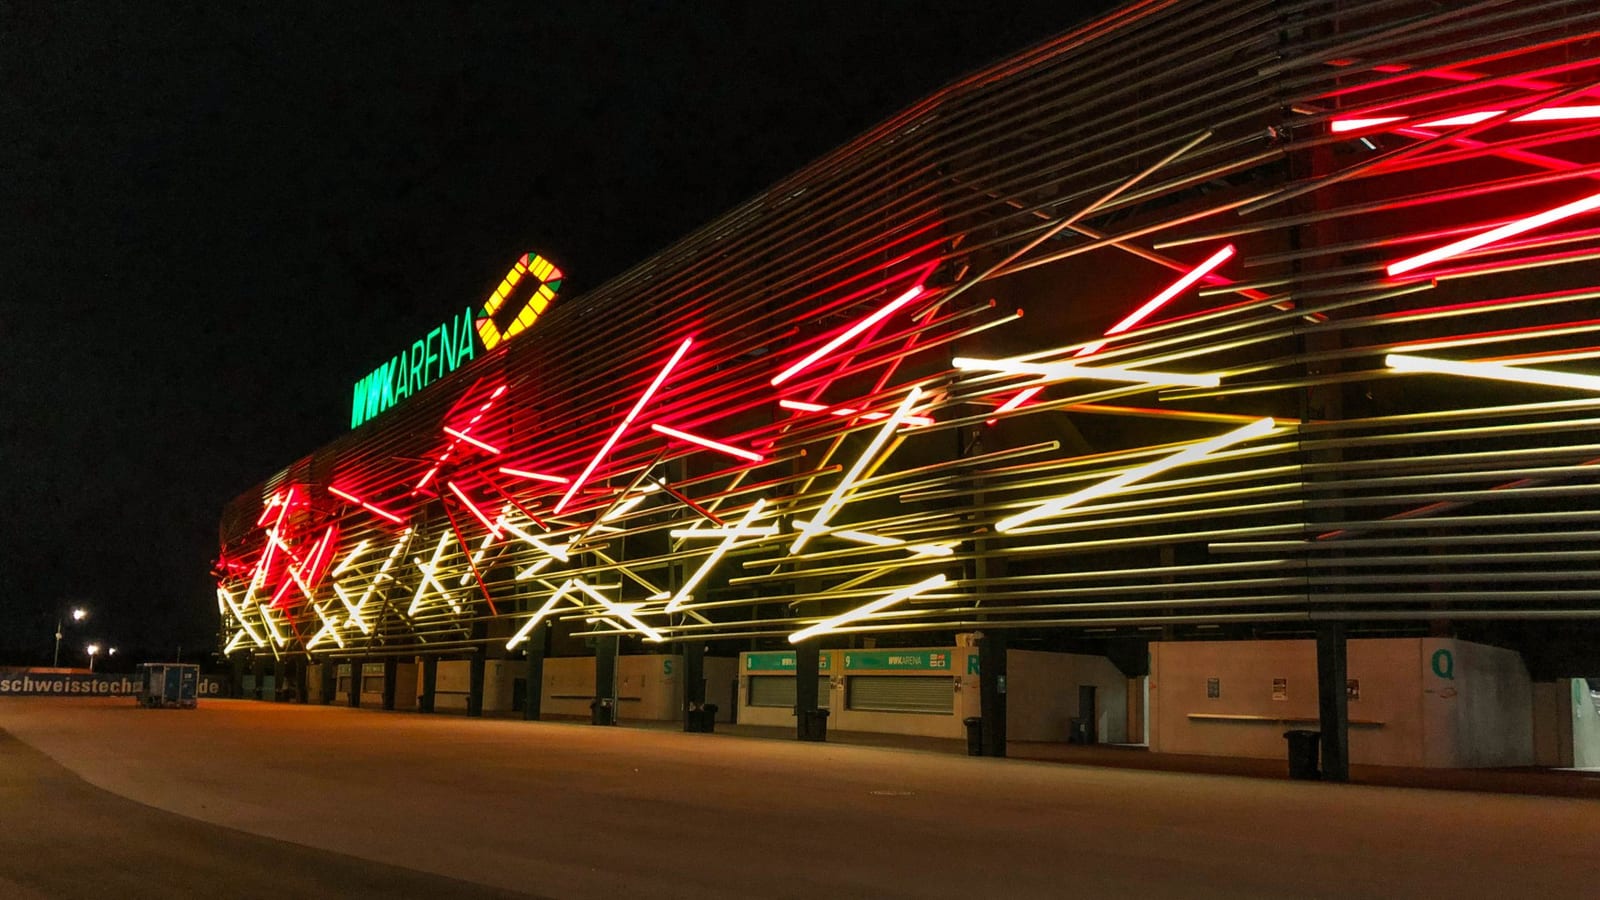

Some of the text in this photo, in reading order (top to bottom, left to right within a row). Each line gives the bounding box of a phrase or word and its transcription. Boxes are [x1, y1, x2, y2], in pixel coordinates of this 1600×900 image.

[663, 659, 673, 675] S
[845, 655, 851, 668] 9
[1431, 648, 1454, 680] Q
